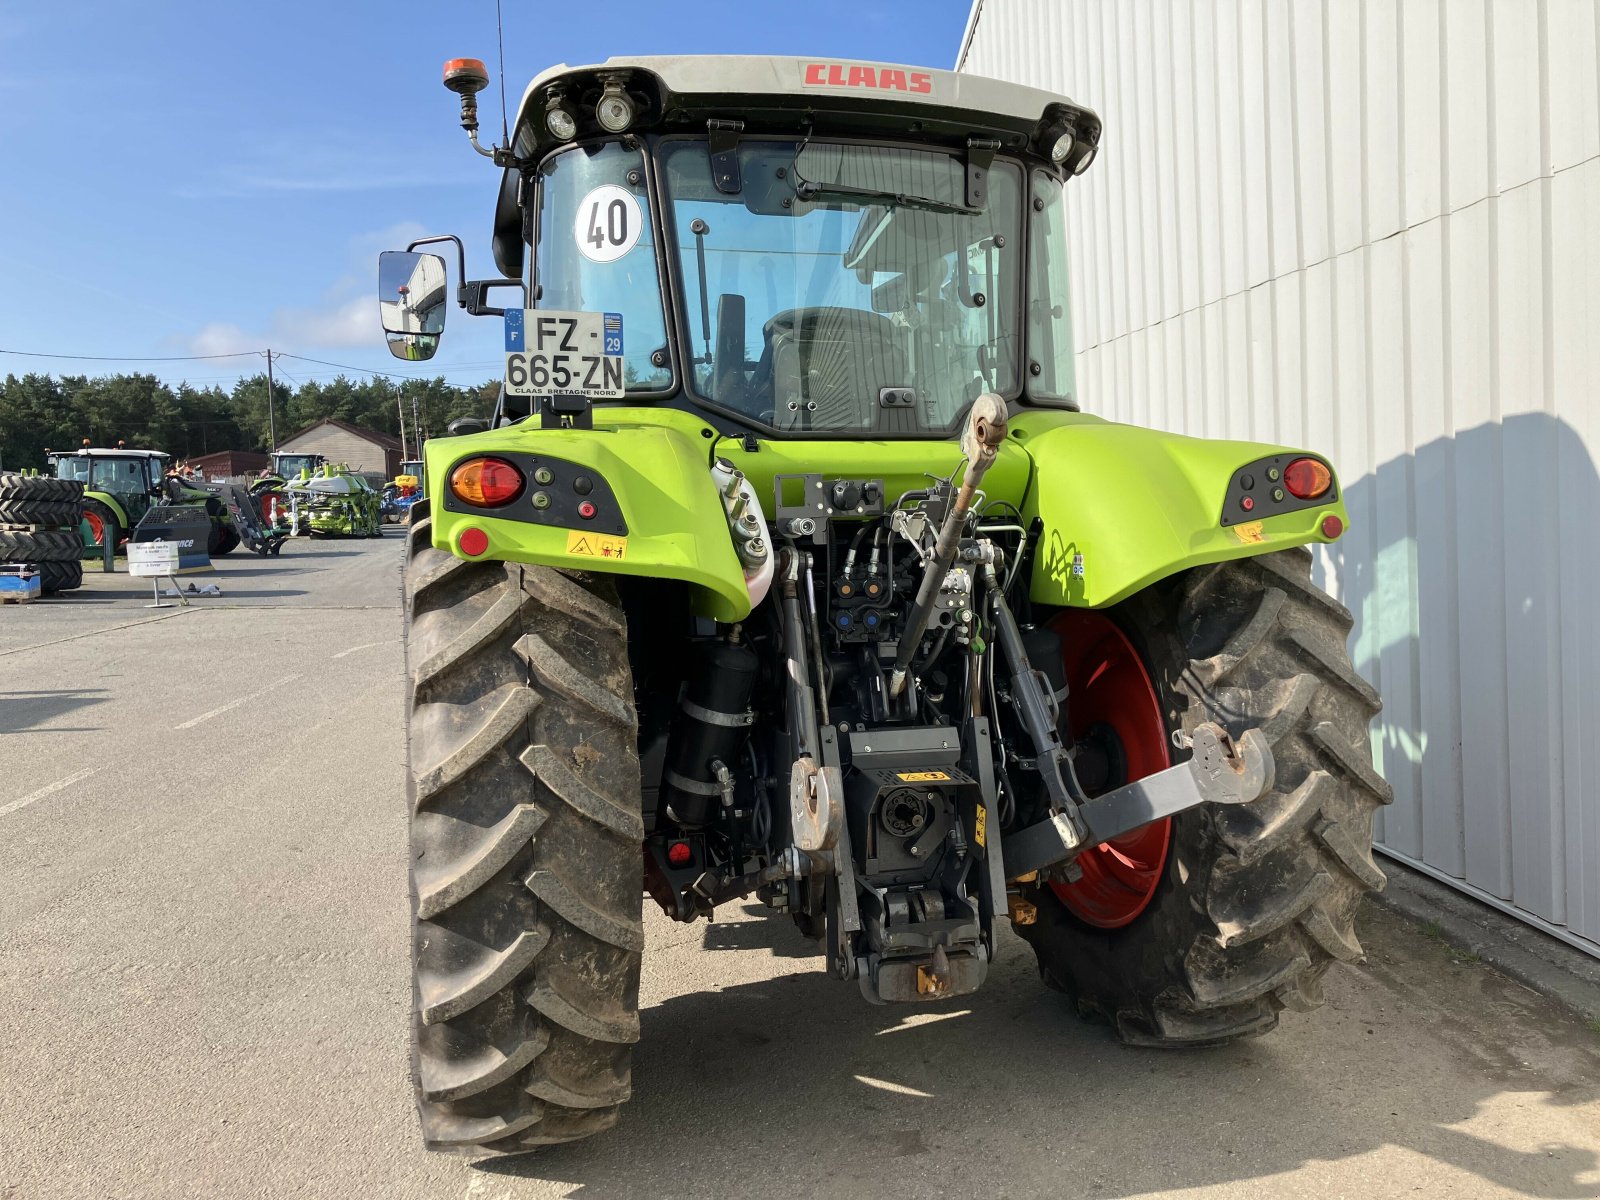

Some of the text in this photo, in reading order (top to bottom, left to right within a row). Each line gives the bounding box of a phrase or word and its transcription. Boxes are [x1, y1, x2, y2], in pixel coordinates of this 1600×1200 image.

[805, 64, 932, 94] CLAAS
[587, 199, 628, 249] 40
[511, 332, 518, 342] F
[606, 338, 620, 352] 29
[508, 354, 622, 389] 665-ZN
